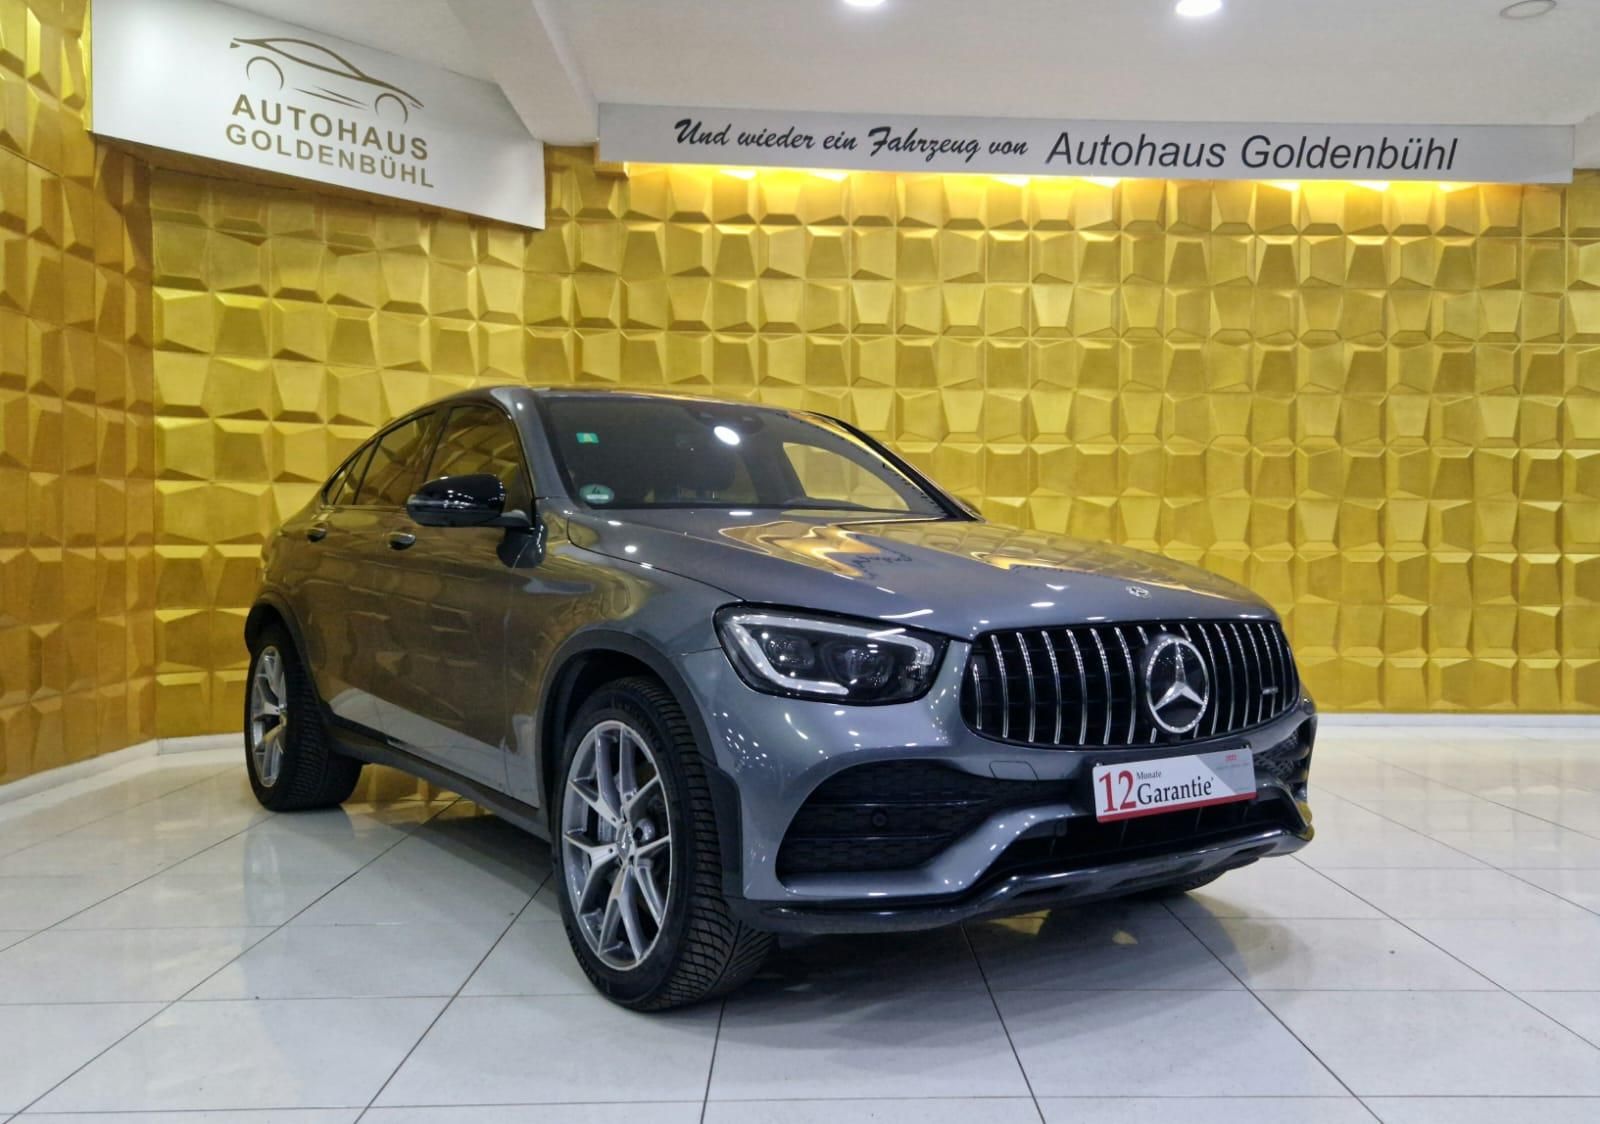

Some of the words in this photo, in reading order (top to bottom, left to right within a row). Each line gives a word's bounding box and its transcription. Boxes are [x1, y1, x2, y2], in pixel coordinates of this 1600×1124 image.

[226, 124, 434, 188] GOLDENBÜHL
[232, 94, 428, 161] AUTOHAUS
[674, 118, 732, 145] Und
[737, 125, 815, 150] wieder
[823, 131, 858, 151] ein
[867, 126, 980, 162] Fahrzeug
[988, 140, 1028, 155] von
[1045, 132, 1226, 168] Autohaus
[1241, 135, 1458, 171] Goldenbühl
[1099, 770, 1136, 812] 12
